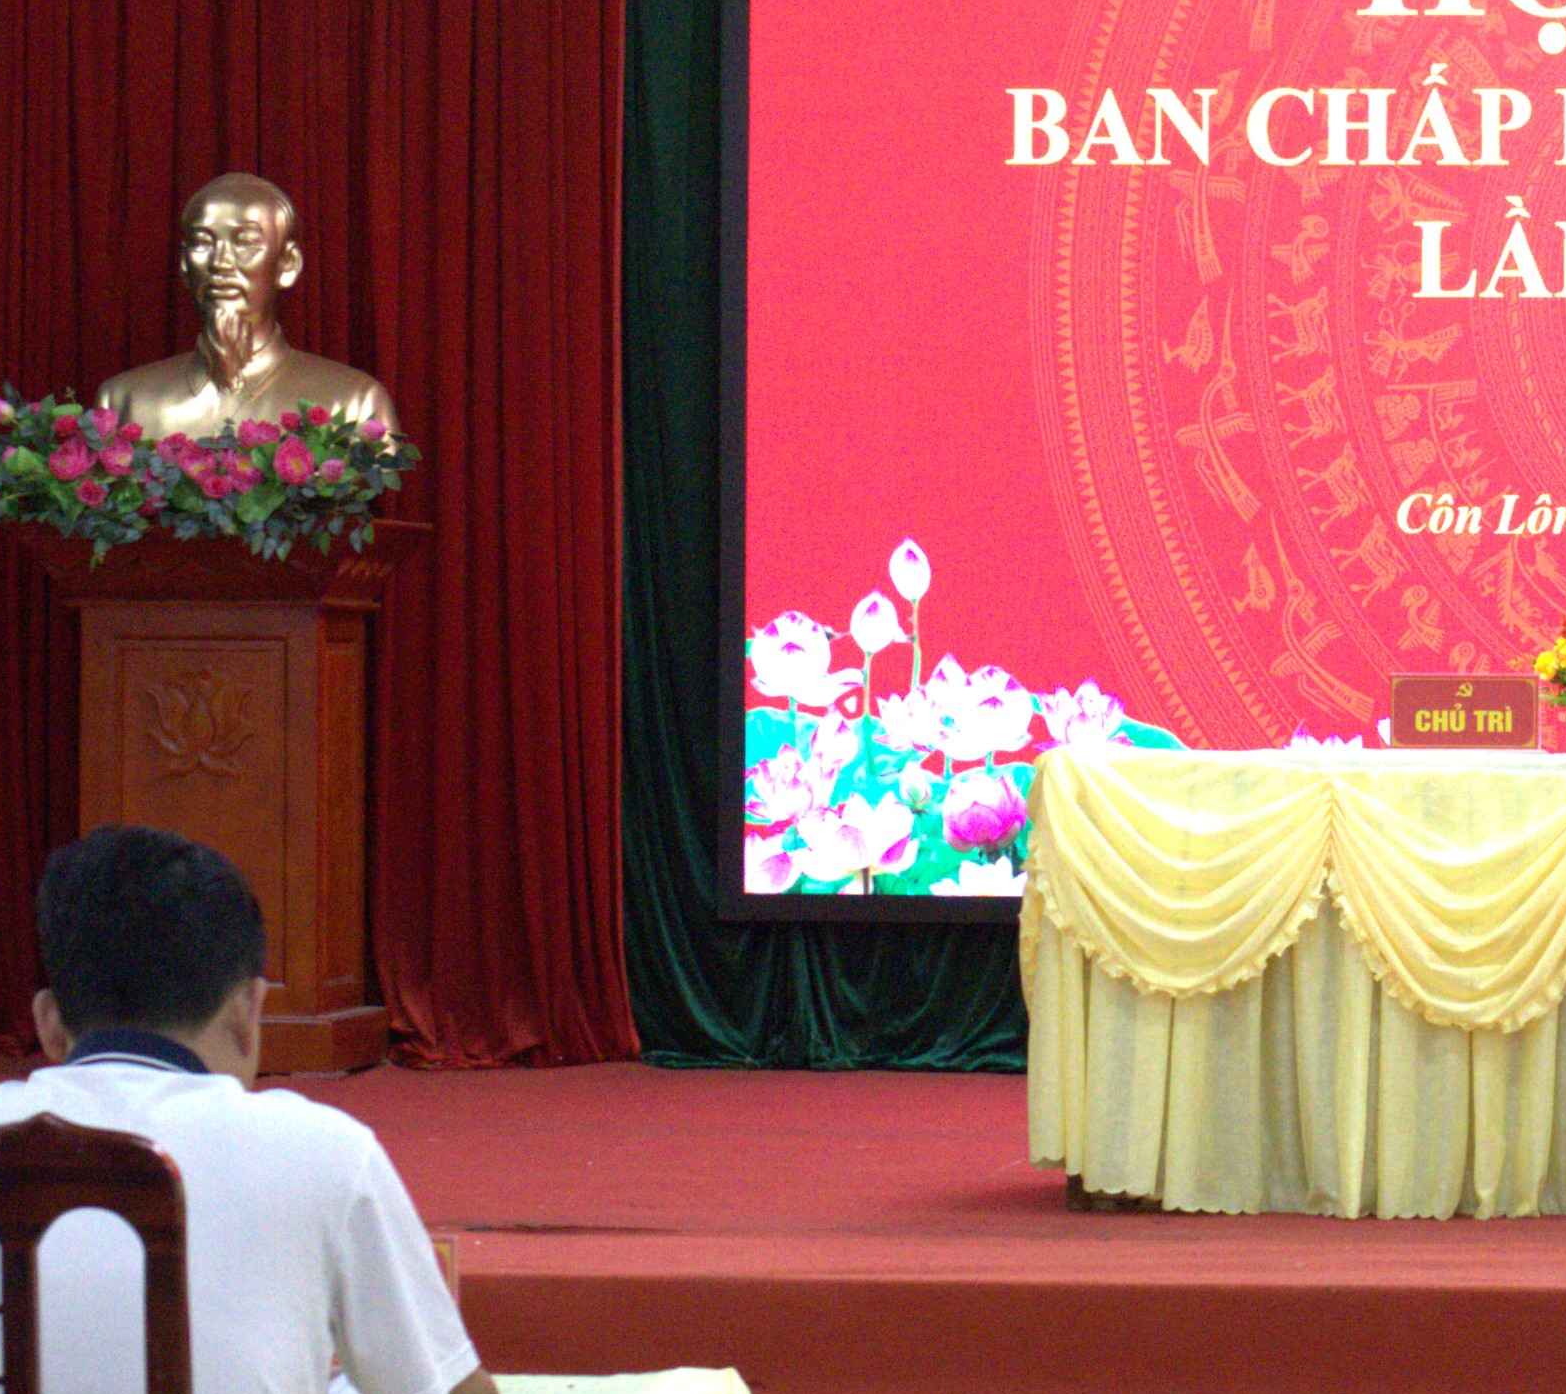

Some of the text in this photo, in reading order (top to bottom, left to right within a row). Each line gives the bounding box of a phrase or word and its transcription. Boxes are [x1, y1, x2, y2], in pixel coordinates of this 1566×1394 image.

[1006, 87, 1217, 165] BAN
[1246, 62, 1532, 167] CHẤP
[1396, 493, 1482, 535] Côn
[1415, 703, 1512, 732] CHỦ TRÌ
